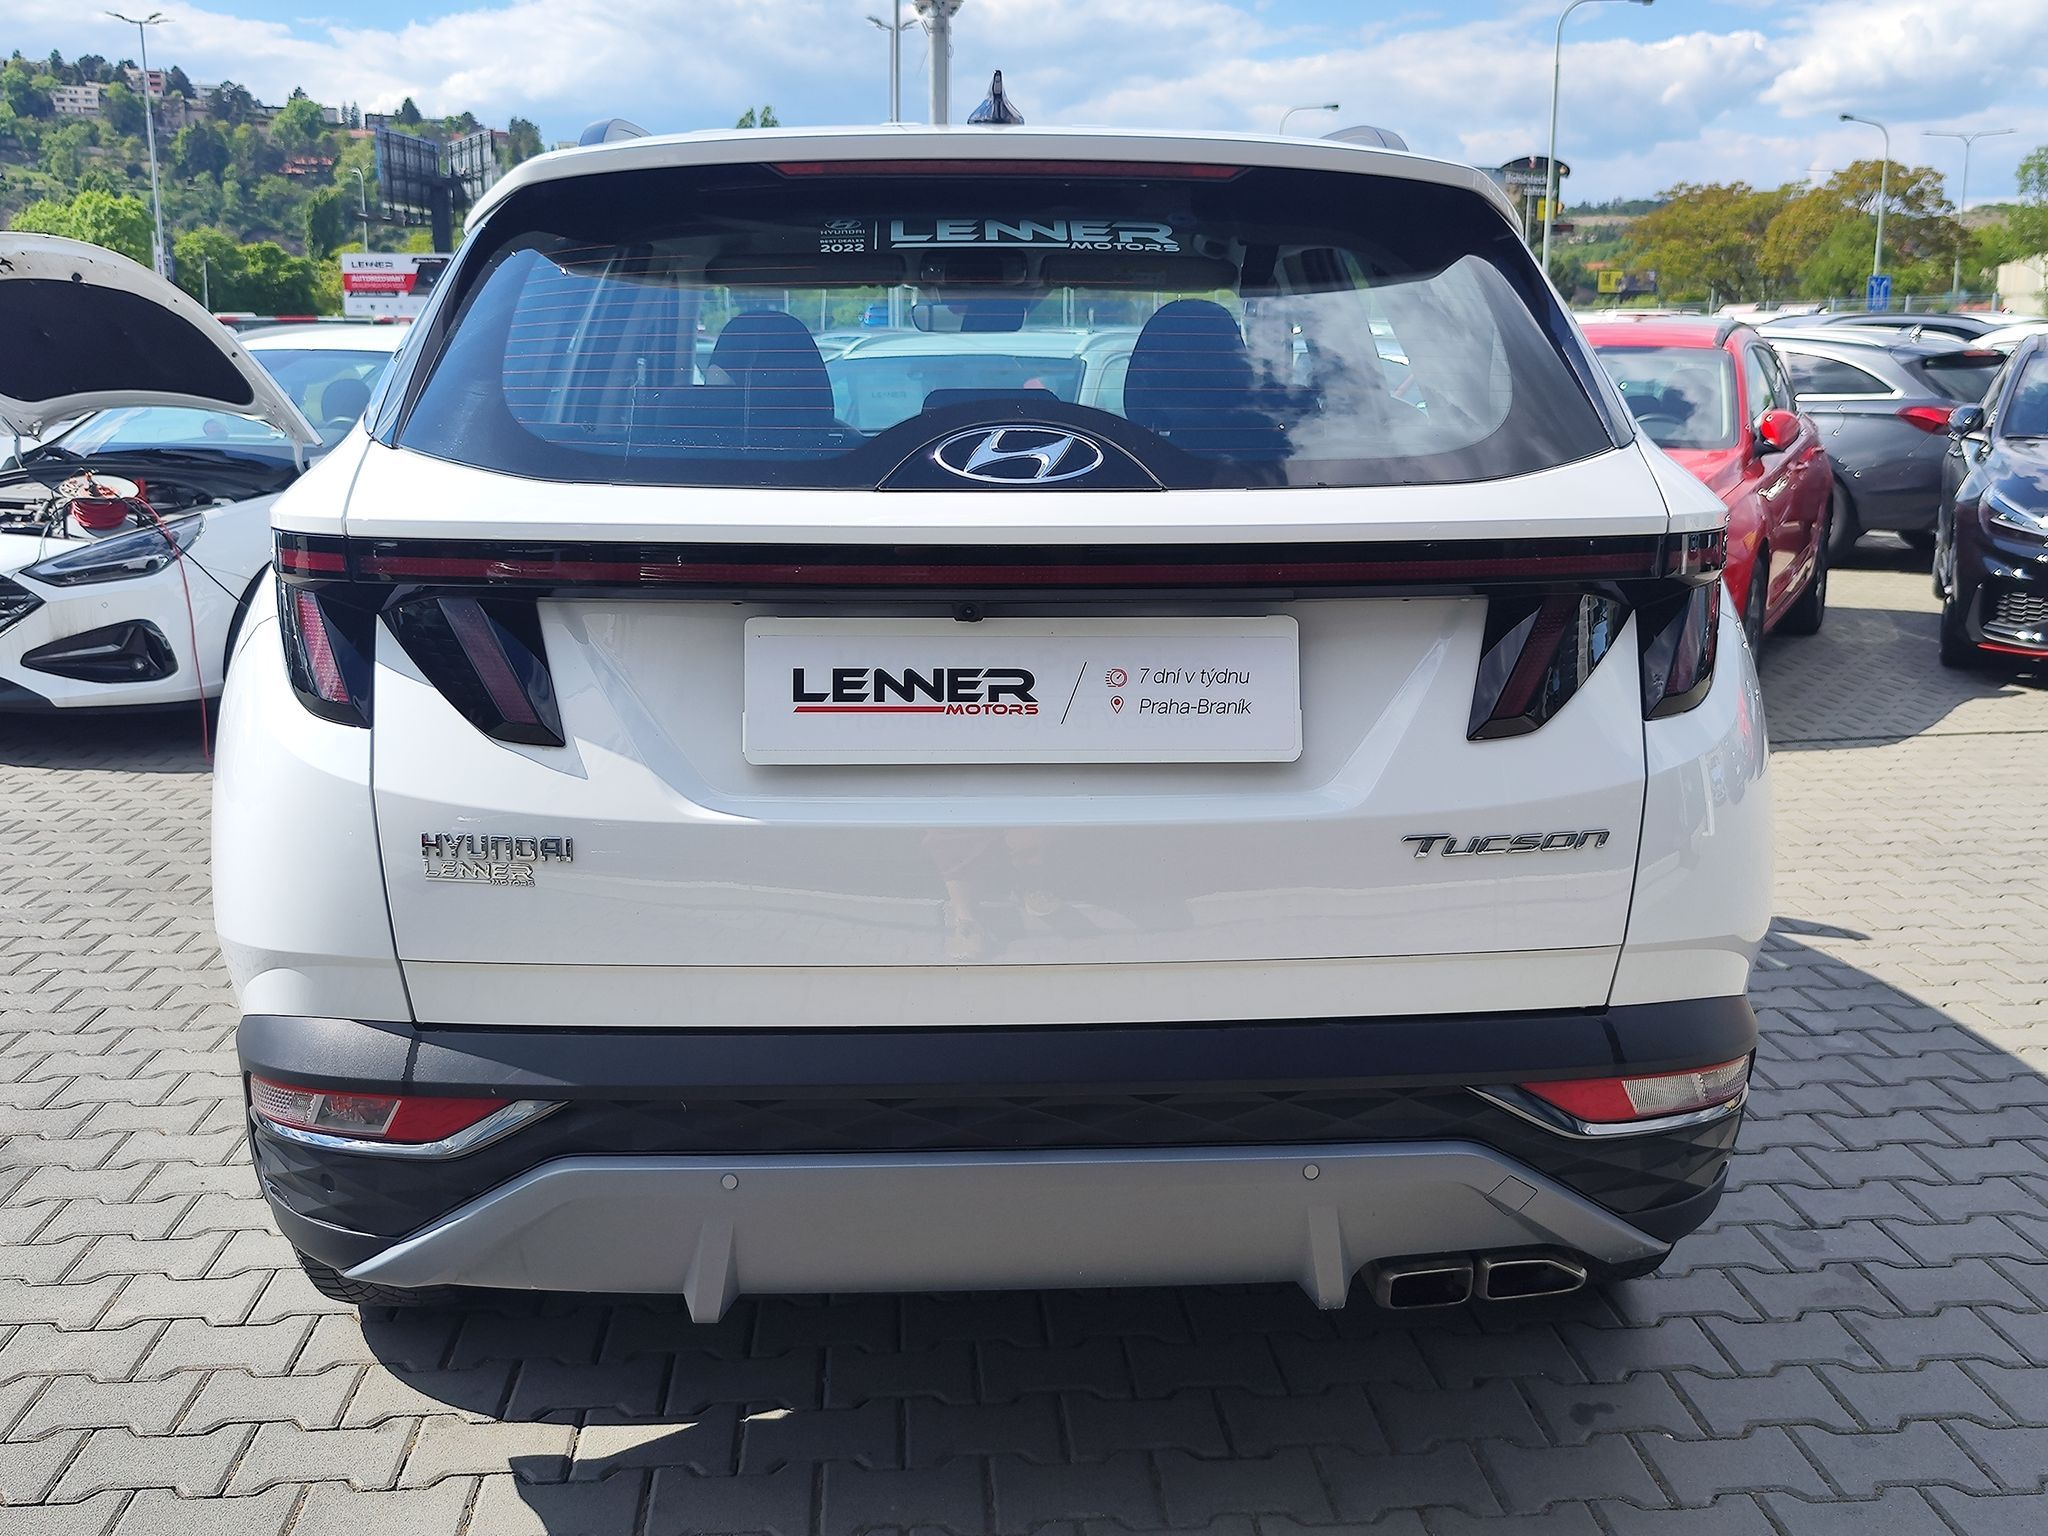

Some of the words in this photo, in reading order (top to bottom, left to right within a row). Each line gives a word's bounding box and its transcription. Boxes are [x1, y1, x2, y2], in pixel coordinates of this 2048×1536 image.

[890, 219, 1178, 244] LENNER
[820, 244, 865, 253] 2022
[1070, 241, 1180, 252] MOTORS
[792, 668, 1039, 703] LENNER
[1140, 667, 1150, 684] 7
[1153, 666, 1182, 684] dní
[1185, 671, 1196, 684] v
[1200, 667, 1250, 688] týdnu
[946, 703, 1039, 715] MOTORS
[1139, 698, 1252, 715] Praha-Braník
[421, 832, 574, 862] HYUNDAI
[422, 858, 535, 881] LENNER
